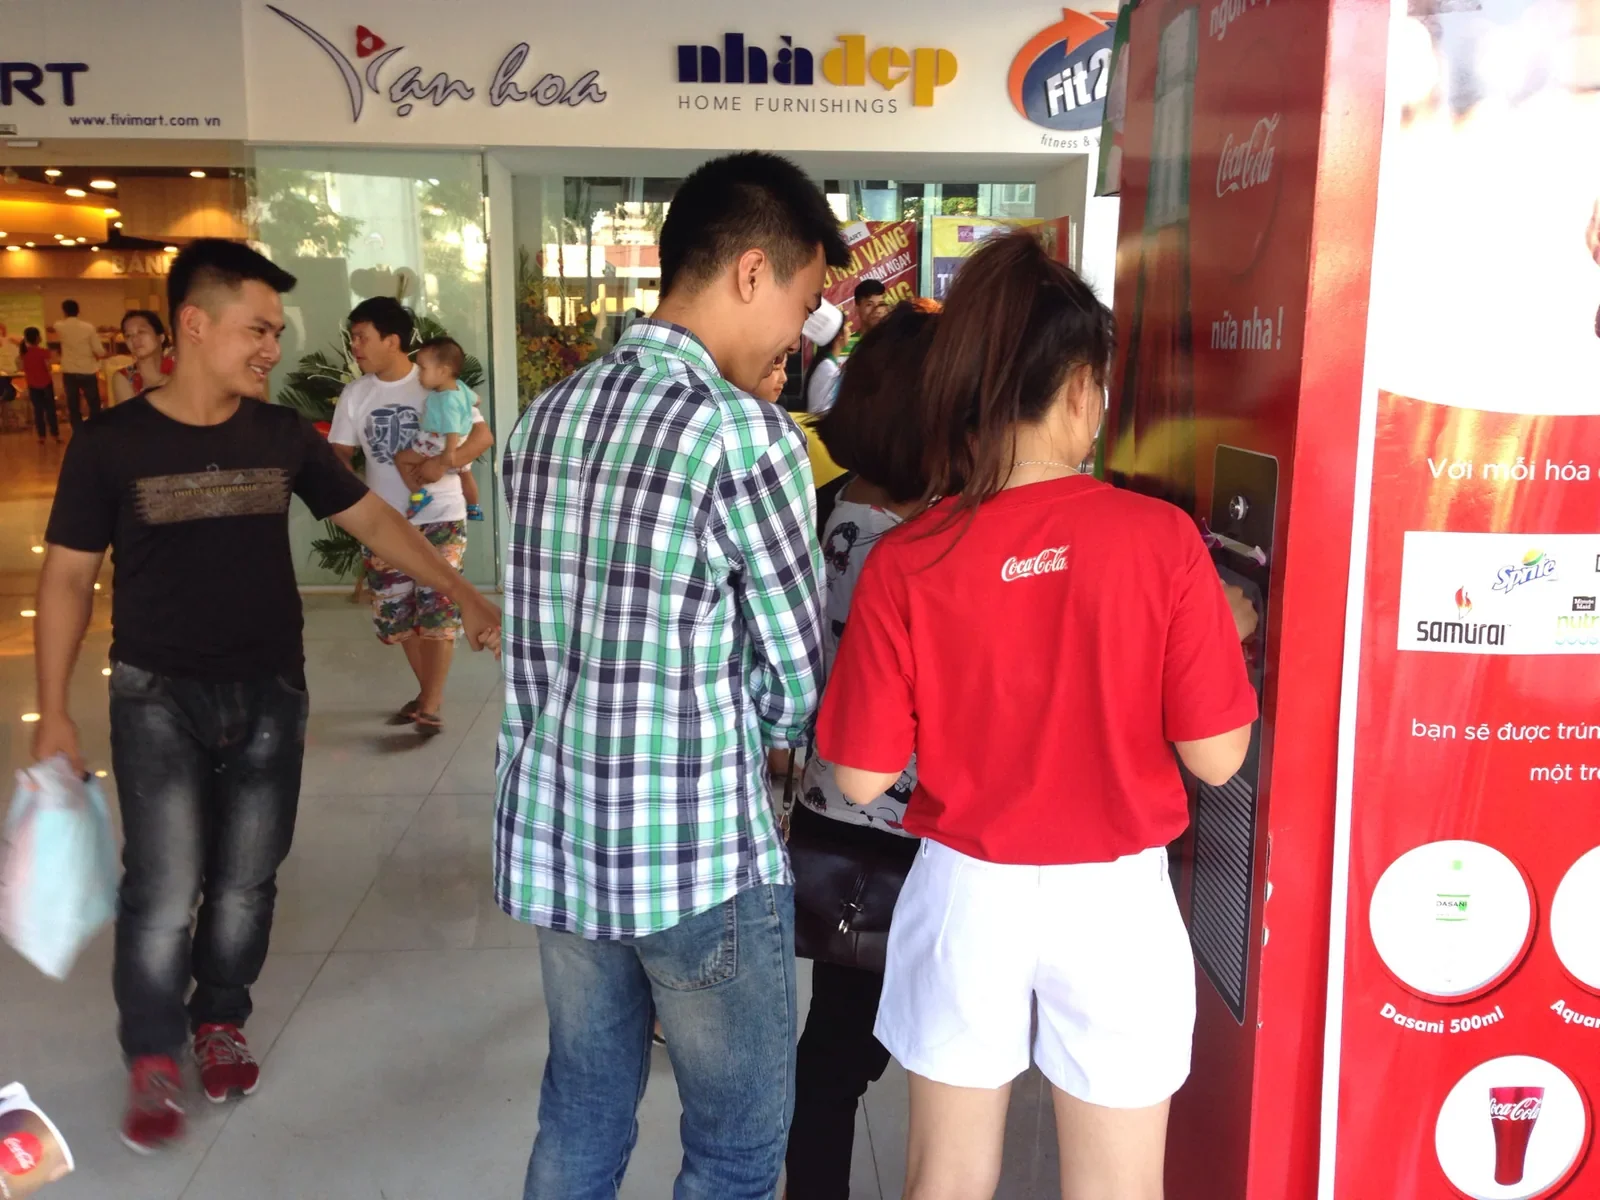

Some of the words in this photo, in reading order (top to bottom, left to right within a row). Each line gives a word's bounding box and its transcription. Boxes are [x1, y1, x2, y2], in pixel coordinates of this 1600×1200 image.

[489, 42, 607, 107] hoa
[678, 95, 742, 112] HOME
[755, 97, 898, 114] FURNISHINGS
[1040, 133, 1078, 149] fitness
[1215, 112, 1281, 198] Coca-Cola
[860, 226, 909, 265] VÀNG
[885, 252, 912, 274] NGAY
[1211, 310, 1238, 350] nữa
[1427, 457, 1472, 481] Với
[1483, 456, 1536, 481] mỗi
[1545, 458, 1591, 481] hóa
[1001, 545, 1070, 582] Coca-Cola
[1416, 620, 1505, 646] samurai
[1411, 718, 1456, 742] bạn
[1464, 722, 1490, 741] sẽ
[1497, 721, 1551, 744] được
[1530, 763, 1573, 785] một
[1380, 1002, 1445, 1034] Dasani
[1450, 1005, 1505, 1034] 500ml
